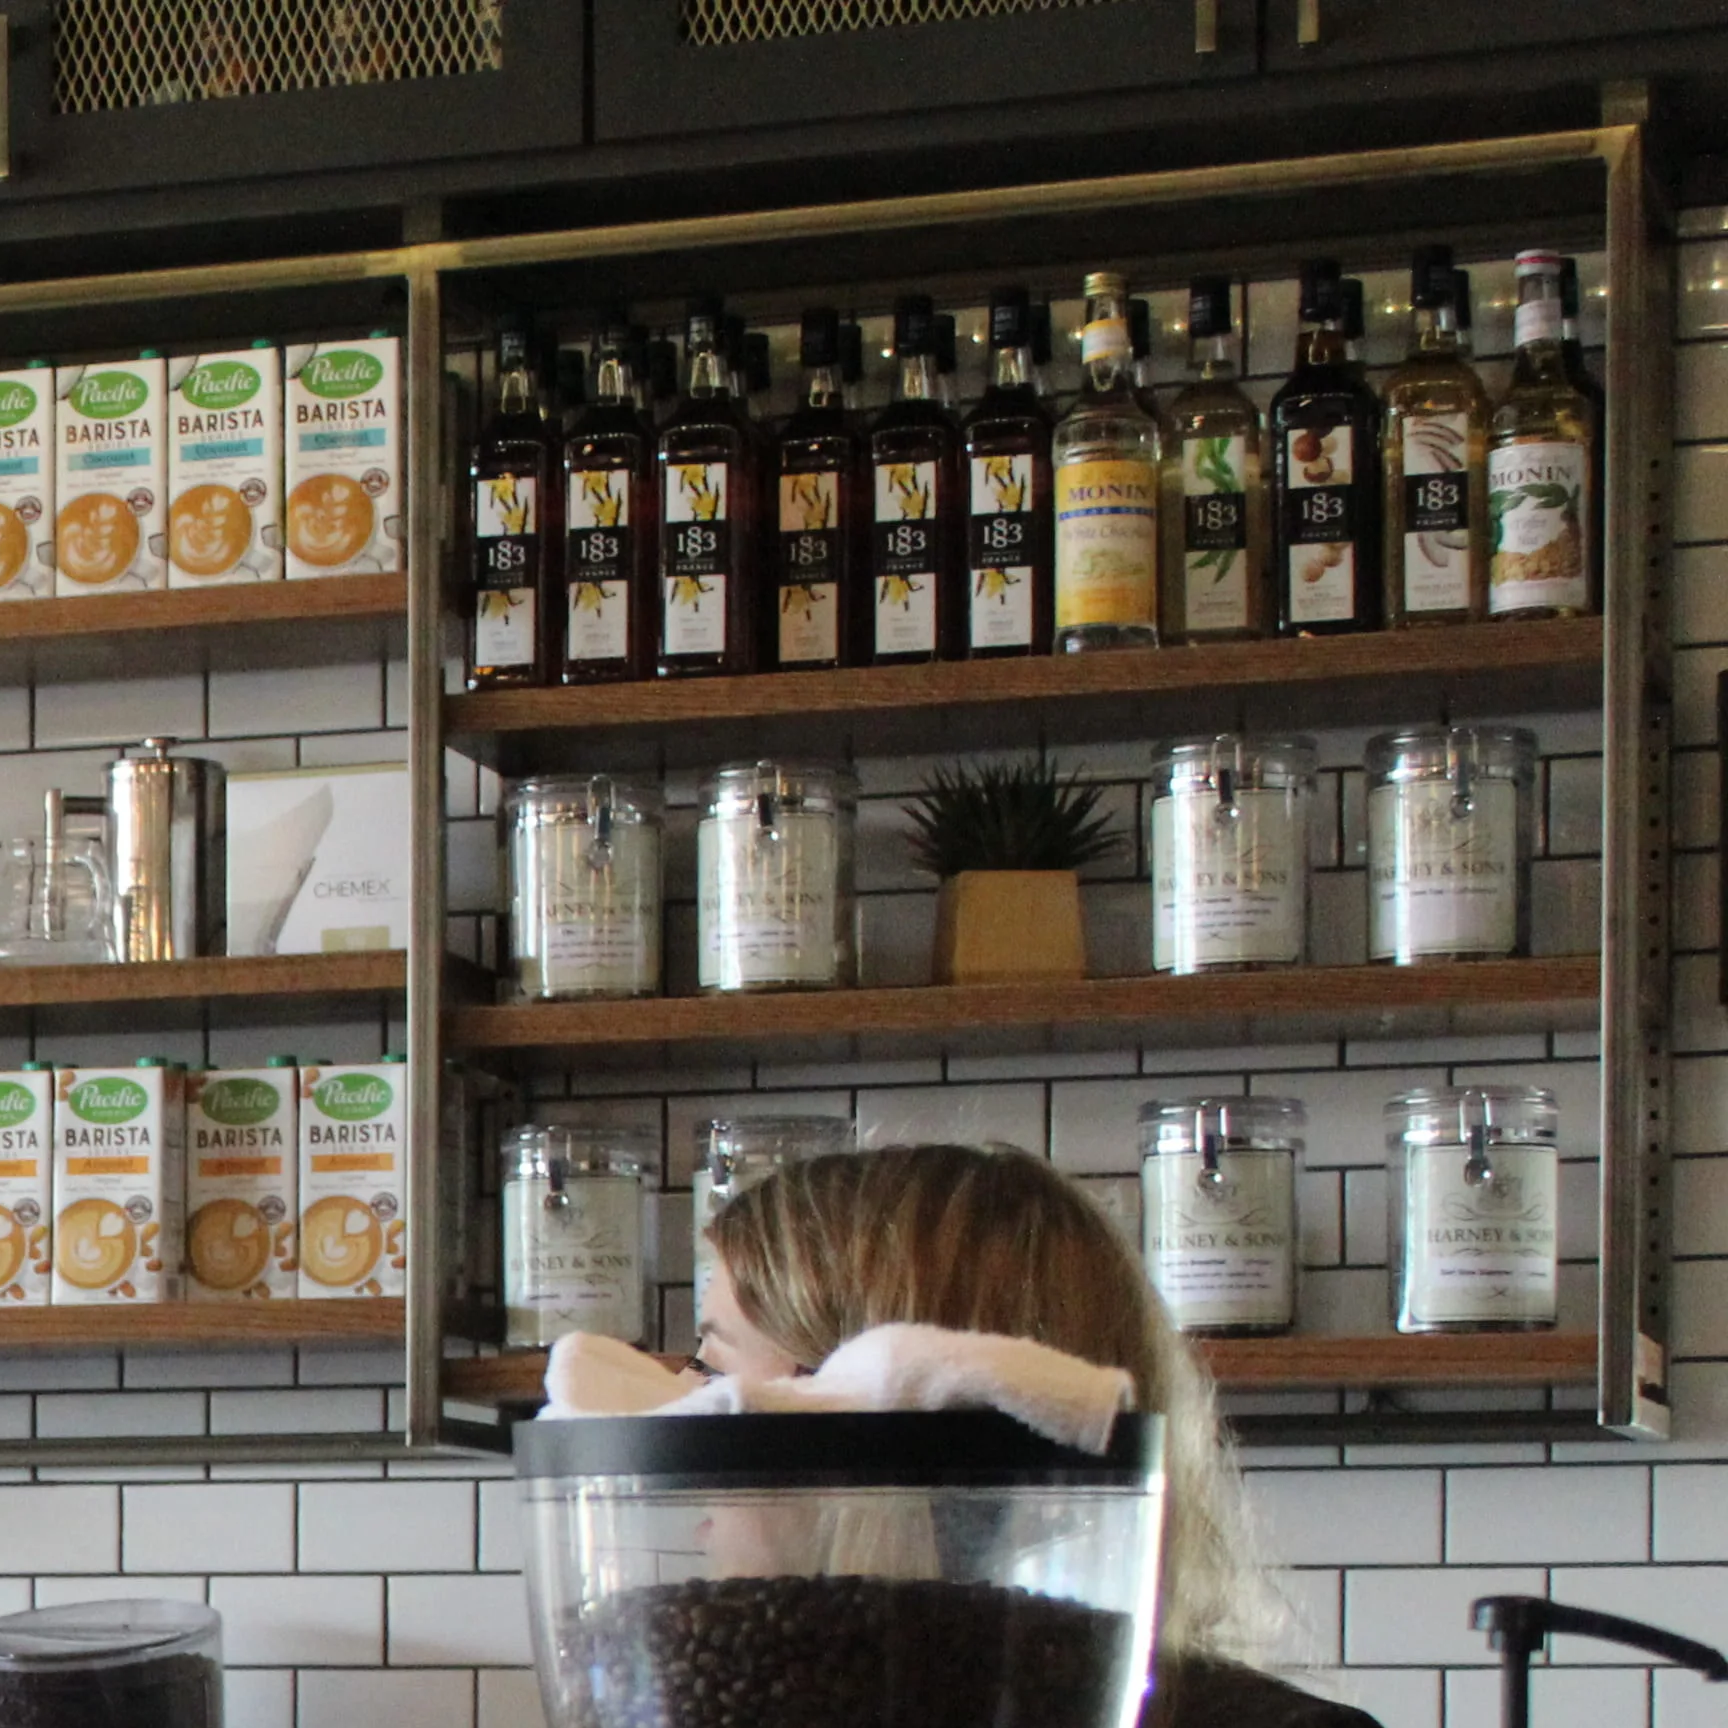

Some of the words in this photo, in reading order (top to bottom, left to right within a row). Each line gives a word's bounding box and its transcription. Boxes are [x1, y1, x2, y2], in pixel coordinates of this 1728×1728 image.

[188, 368, 254, 396] Pacific
[308, 354, 376, 386] Pacific
[76, 379, 142, 408] Pacific
[177, 408, 264, 435] BARISTA
[296, 398, 387, 424] BARISTA
[65, 418, 152, 444] BARISTA
[1490, 465, 1574, 486] MONIN
[1069, 482, 1148, 502] MONIN
[1416, 479, 1459, 511] 1883
[1197, 500, 1237, 530] 1883
[1302, 492, 1343, 523] 1883
[581, 532, 619, 562] 1883
[677, 526, 717, 557] 1883
[887, 525, 926, 555] 1883
[984, 518, 1023, 548] 1883
[488, 540, 525, 570] 1883
[790, 535, 827, 566] 1883
[313, 878, 391, 899] CHEMEX
[65, 1126, 152, 1148] BARISTA
[196, 1127, 283, 1149] BARISTA
[309, 1122, 396, 1145] BARISTA
[1428, 1227, 1503, 1244] HARNEY
